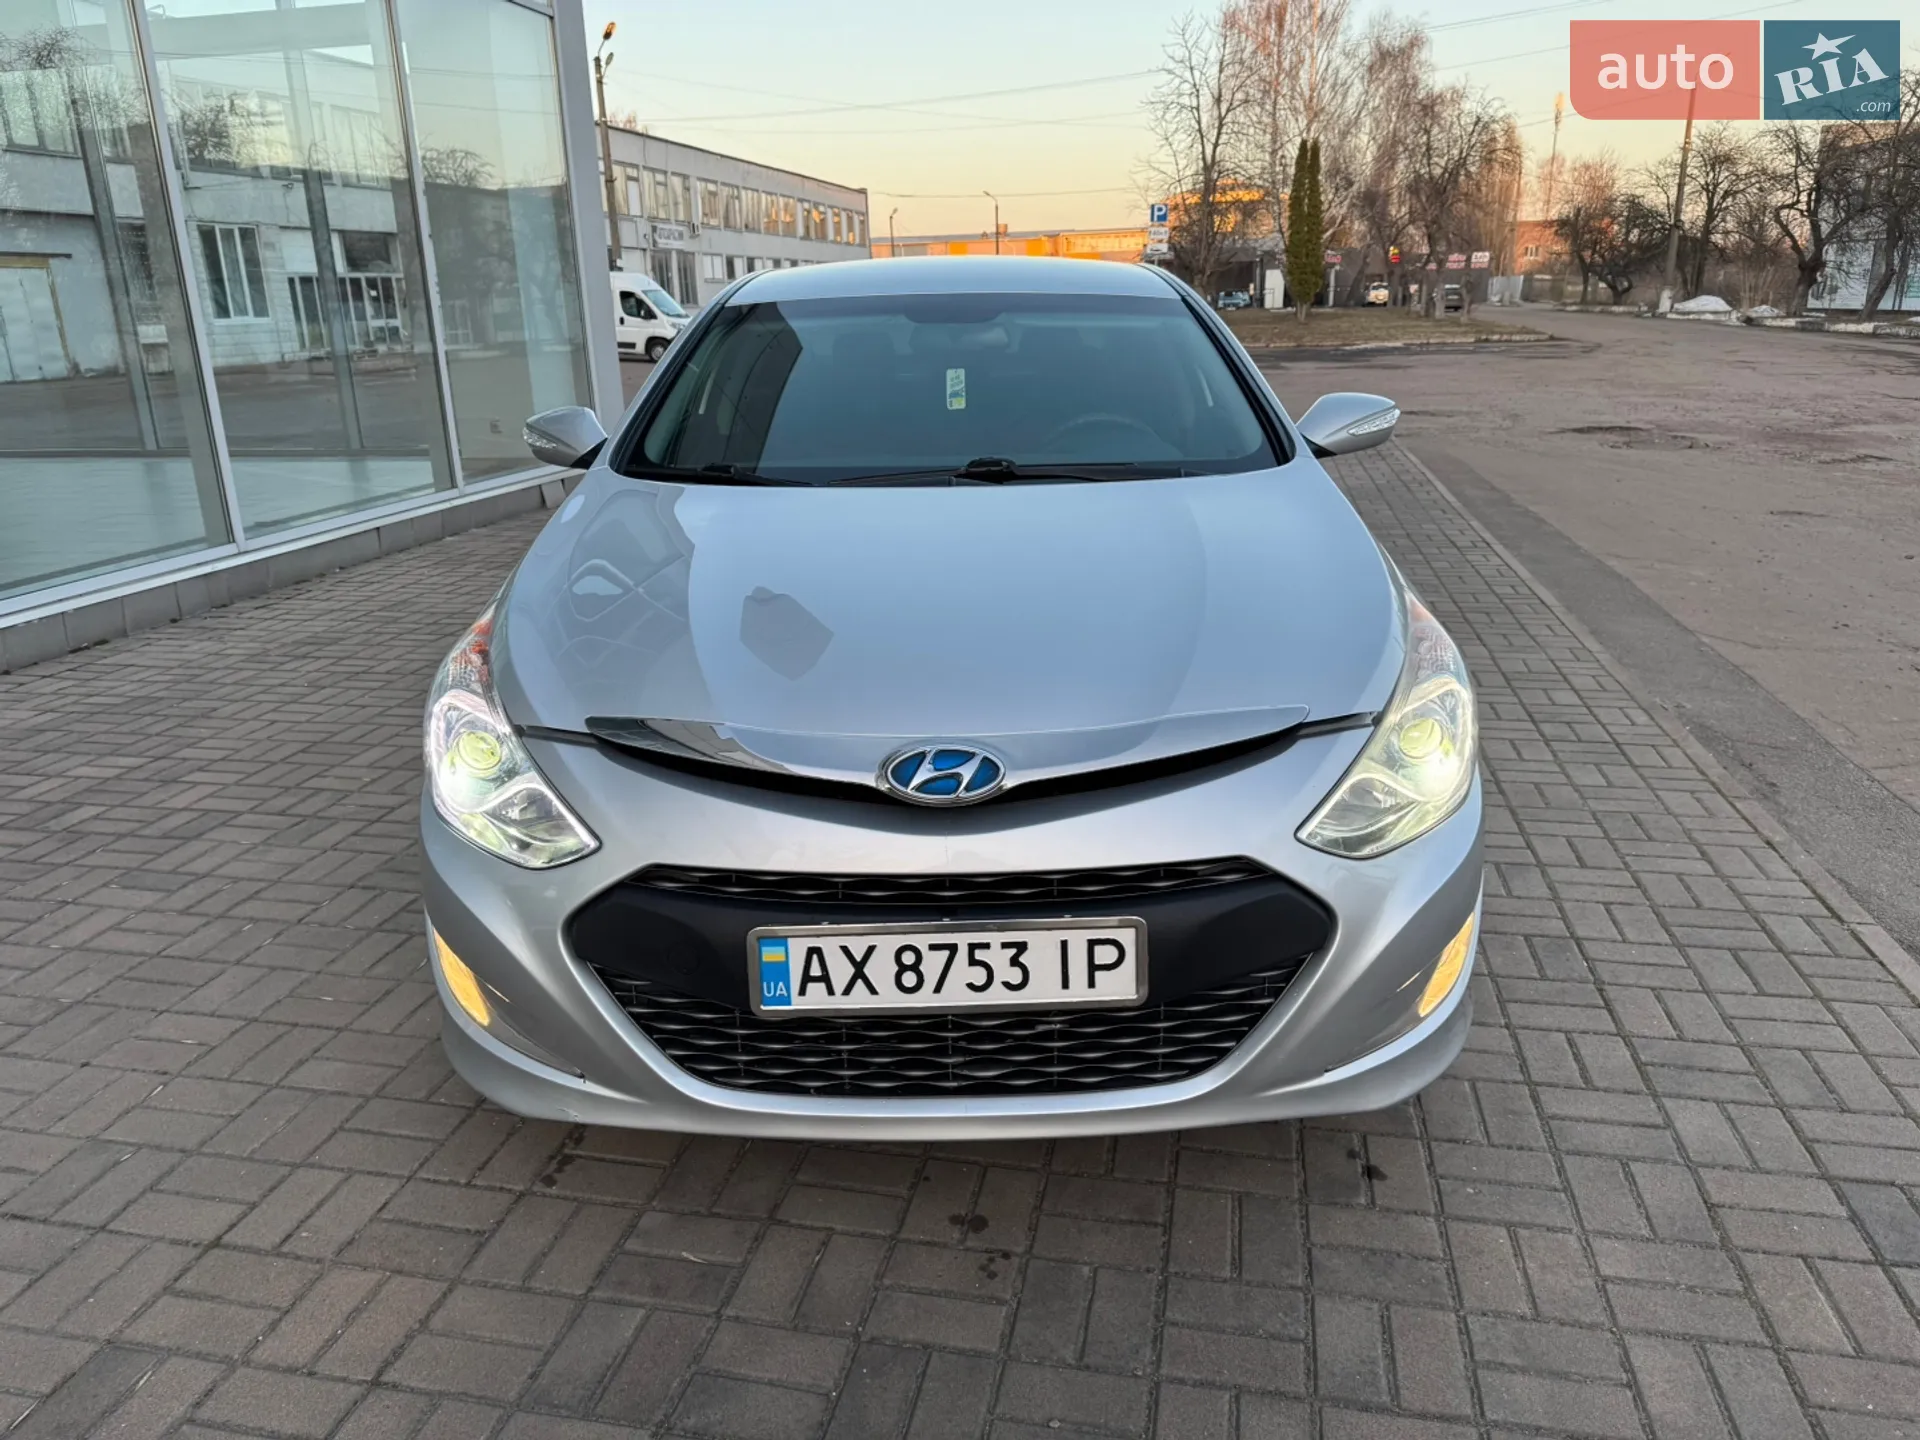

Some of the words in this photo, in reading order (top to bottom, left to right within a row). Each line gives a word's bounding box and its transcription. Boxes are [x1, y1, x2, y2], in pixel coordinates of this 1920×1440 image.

[1153, 204, 1167, 222] P
[797, 944, 880, 997] AX
[893, 940, 1031, 995] 8753
[1059, 936, 1127, 990] IP
[762, 980, 789, 998] UA
